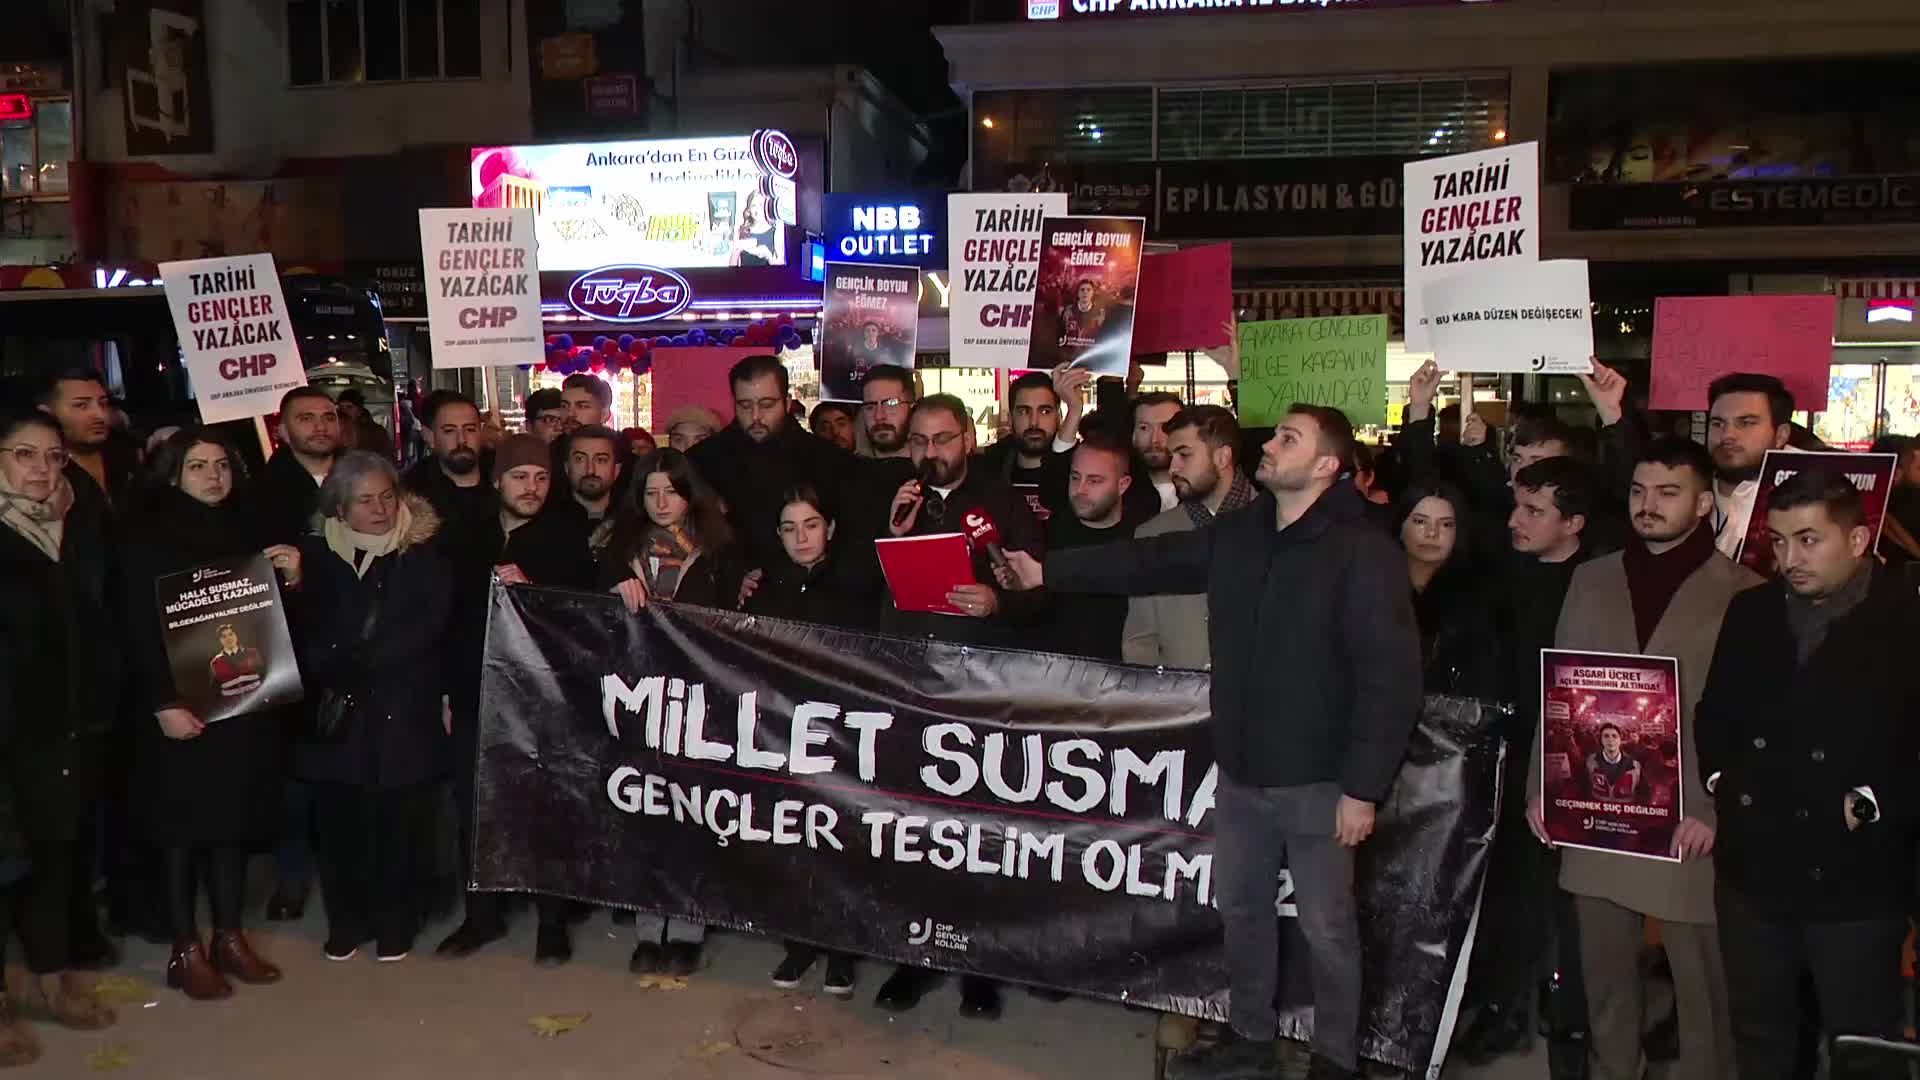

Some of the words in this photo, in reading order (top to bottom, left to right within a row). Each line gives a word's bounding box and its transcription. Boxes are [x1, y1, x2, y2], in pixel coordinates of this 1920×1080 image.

[585, 150, 683, 167] Ankara'dan
[688, 148, 708, 161] En
[1433, 158, 1510, 200] TARİHİ
[1166, 181, 1327, 213] EPİLASYON
[1336, 184, 1353, 209] &
[1360, 178, 1404, 209] GÜ
[853, 205, 921, 232] NBB
[975, 204, 1044, 233] TARİHİ
[1421, 196, 1522, 234] GENÇLER
[447, 216, 513, 244] TARİHİ
[1052, 228, 1093, 251] GENÇLİK
[1097, 232, 1131, 248] BOYUN
[840, 233, 934, 256] OUTLET
[1420, 229, 1525, 267] YAZACAK
[439, 248, 526, 276] GENÇLER
[1071, 251, 1106, 266] EĞMEZ
[190, 264, 256, 296] TARİHİ
[440, 274, 529, 298] YAZACAK
[835, 276, 875, 293] GENÇLİK
[877, 279, 908, 293] BOYUN
[187, 294, 273, 325] GENÇLER
[855, 294, 887, 310] EĞMEZ
[458, 306, 518, 330] CHP
[1436, 316, 1450, 325] BU
[1453, 312, 1481, 322] KARA
[1484, 308, 1518, 320] DÜZEN
[1521, 305, 1583, 323] DEĞİŞECEK!
[192, 320, 282, 351] YAZACAK
[219, 353, 277, 381] CHP
[166, 593, 221, 614] MÜCADELE
[222, 583, 270, 601] KAZANIR!
[179, 588, 207, 602] HALK
[1573, 667, 1606, 679] ASGARİ
[1608, 669, 1641, 681] ÜCRET
[600, 672, 894, 783] MİLLET
[1602, 804, 1623, 815] SUÇ
[606, 766, 844, 852] GENÇLER
[861, 810, 1065, 883] TESLİM
[935, 923, 954, 932] CHP
[935, 931, 969, 944] GENÇLİK
[934, 939, 967, 952] KOLLARI
